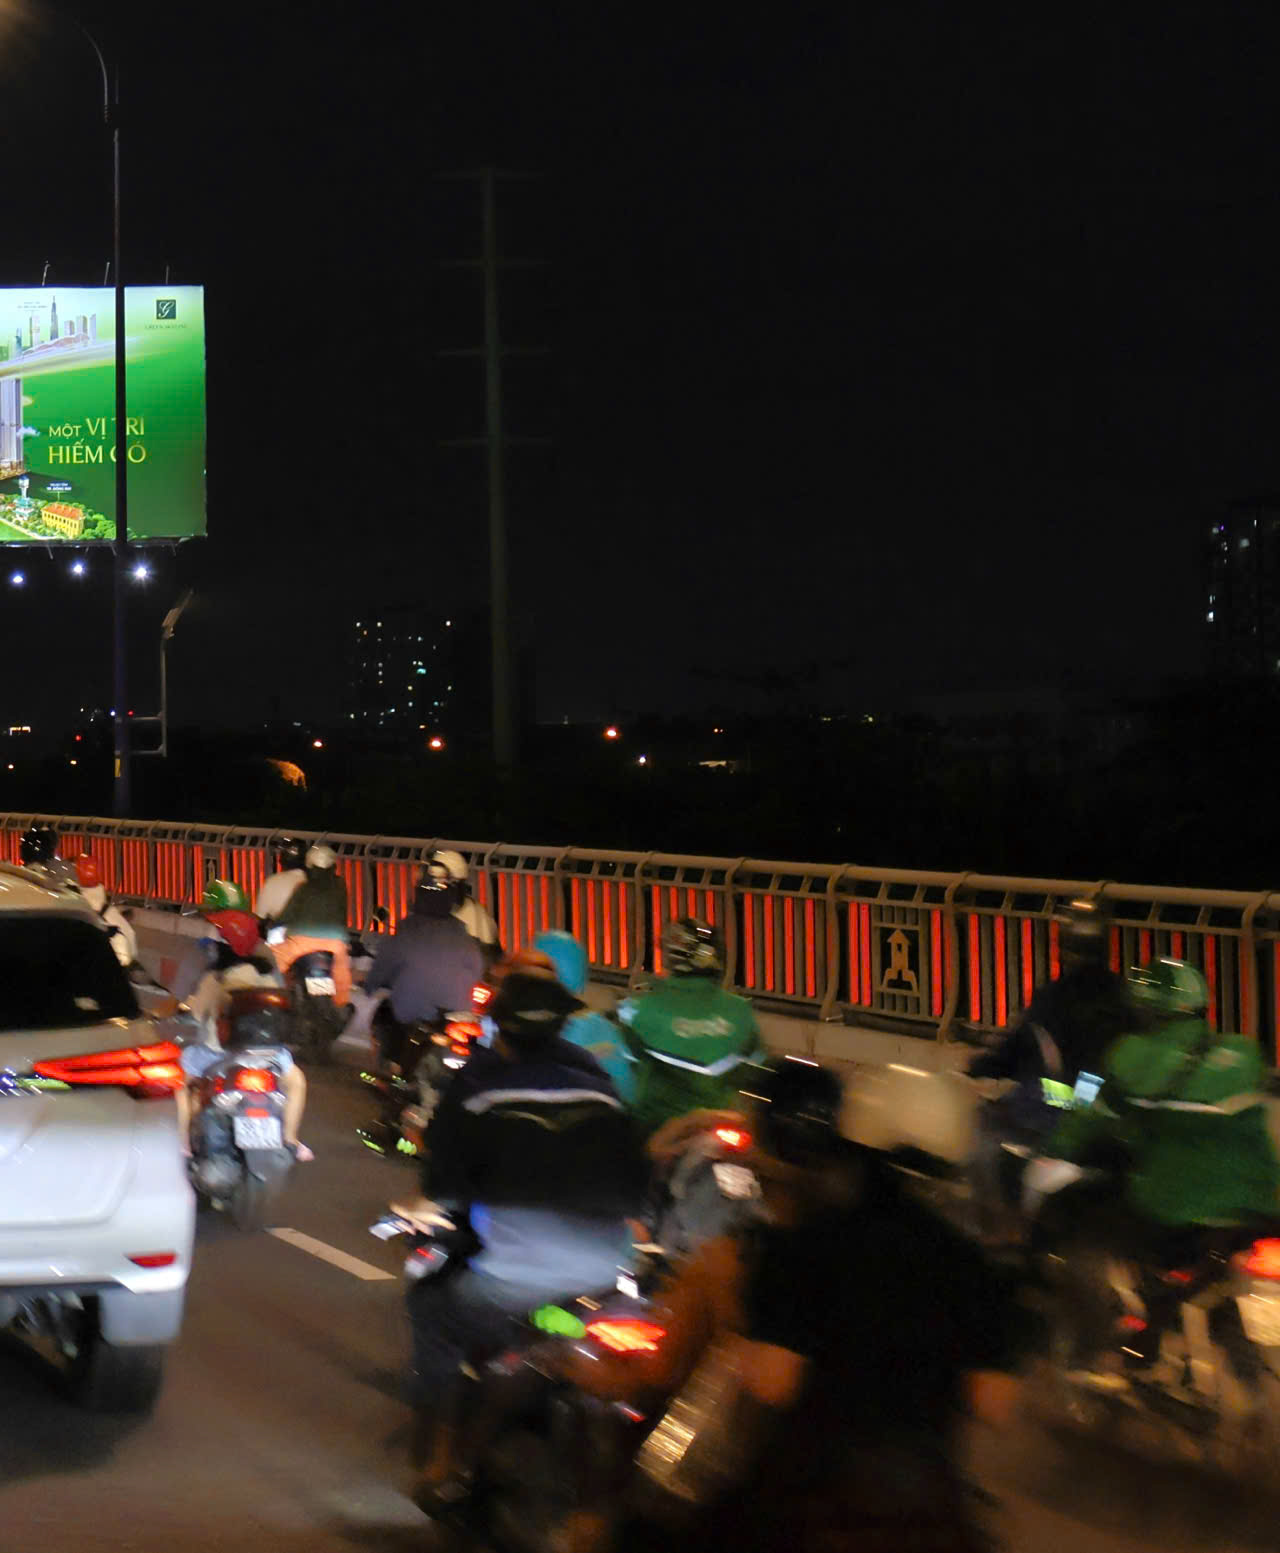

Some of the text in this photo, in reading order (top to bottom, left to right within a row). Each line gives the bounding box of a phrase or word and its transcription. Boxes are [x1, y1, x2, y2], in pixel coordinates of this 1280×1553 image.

[48, 423, 82, 439] MỘT
[85, 417, 107, 440] VỊ
[48, 439, 104, 464] HIẾM
